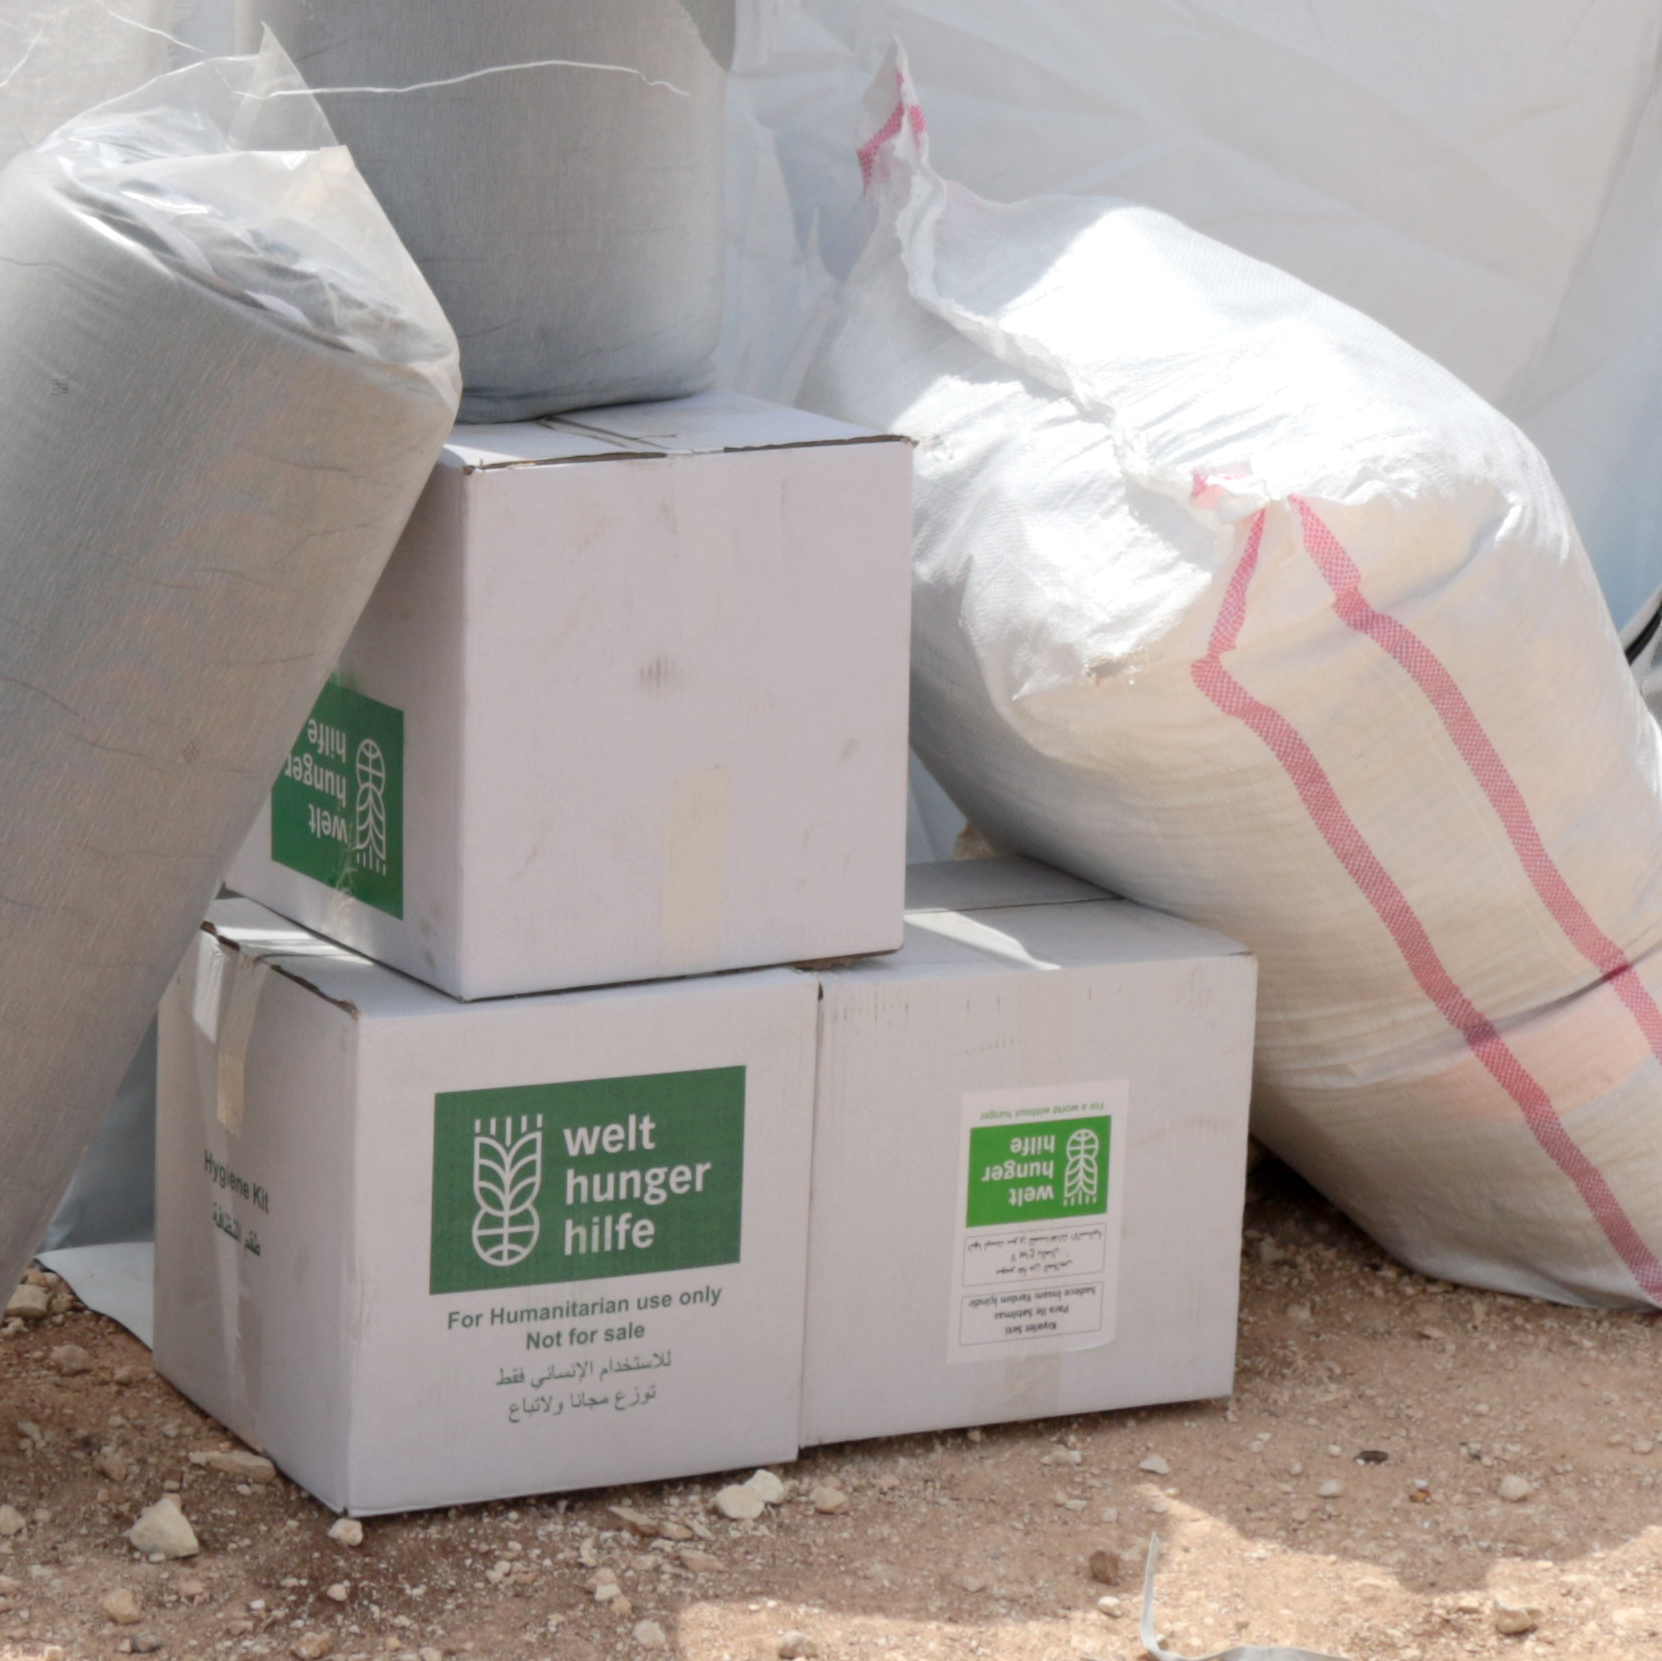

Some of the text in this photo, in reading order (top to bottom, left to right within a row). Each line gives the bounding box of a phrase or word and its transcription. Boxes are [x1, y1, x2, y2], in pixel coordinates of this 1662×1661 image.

[307, 719, 346, 764] hilfe
[285, 753, 346, 808] hunger
[308, 803, 348, 843] welt
[563, 1113, 656, 1157] welt
[1010, 1135, 1056, 1157] hilfe
[204, 1150, 269, 1213] Hygiene Kit
[564, 1158, 711, 1206] hunger
[982, 1161, 1054, 1182] hunger
[1009, 1188, 1054, 1207] welt
[564, 1211, 655, 1255] hilfe
[448, 1284, 722, 1329] For Humanitarian use only
[1050, 1305, 1069, 1313] Para
[526, 1321, 645, 1351] Not for sale
[1005, 1325, 1023, 1336] Seti
[495, 1368, 525, 1386] فقط
[599, 1350, 671, 1379] للاستخدام
[614, 1385, 656, 1410] توزع
